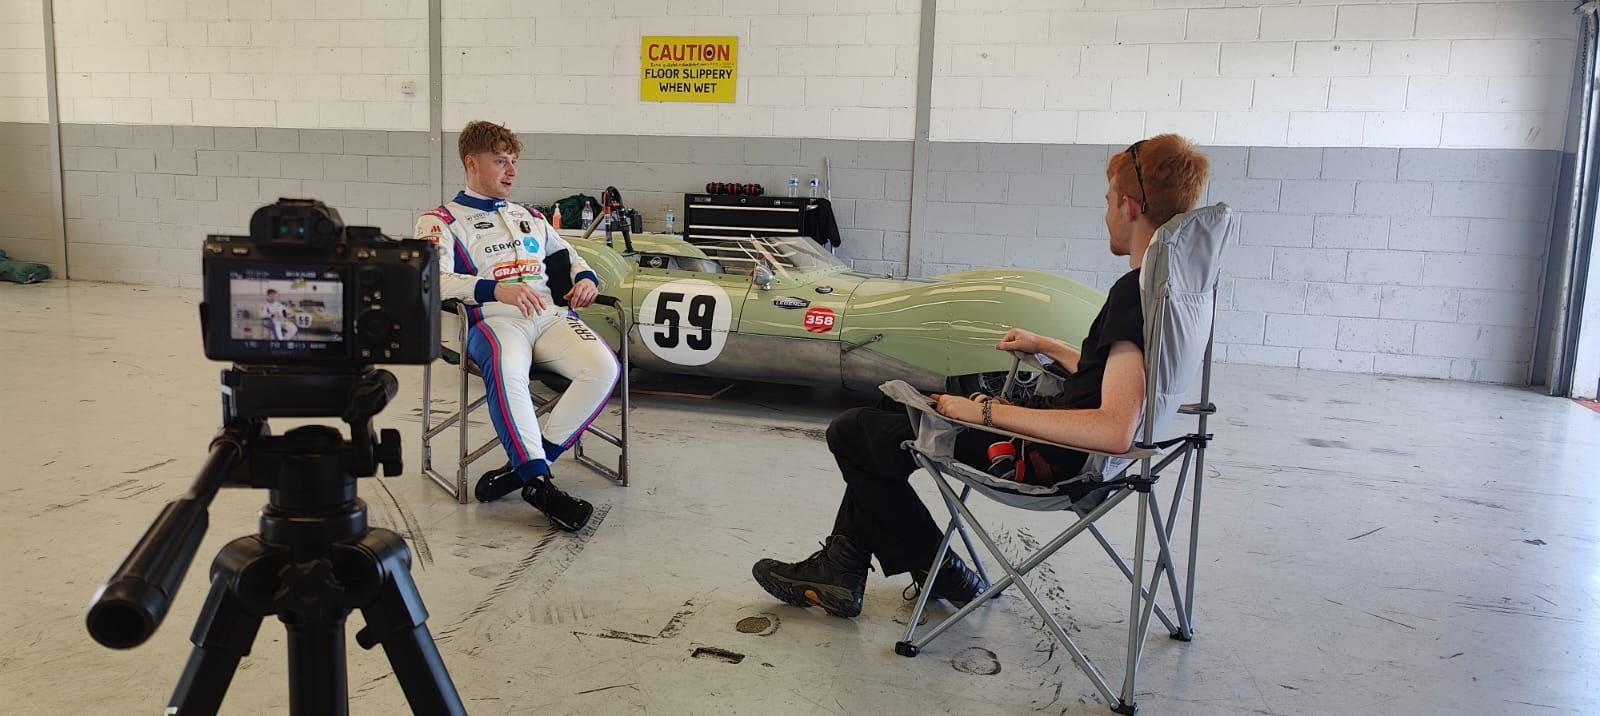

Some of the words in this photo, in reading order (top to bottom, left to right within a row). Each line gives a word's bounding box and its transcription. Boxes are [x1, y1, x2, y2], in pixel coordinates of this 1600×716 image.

[648, 43, 730, 61] CAUTION
[645, 68, 680, 79] FLOOR
[682, 68, 733, 79] SLIPPERY
[659, 82, 691, 93] WHEN
[694, 82, 717, 93] WET
[654, 291, 717, 350] 59
[805, 314, 834, 326] 358
